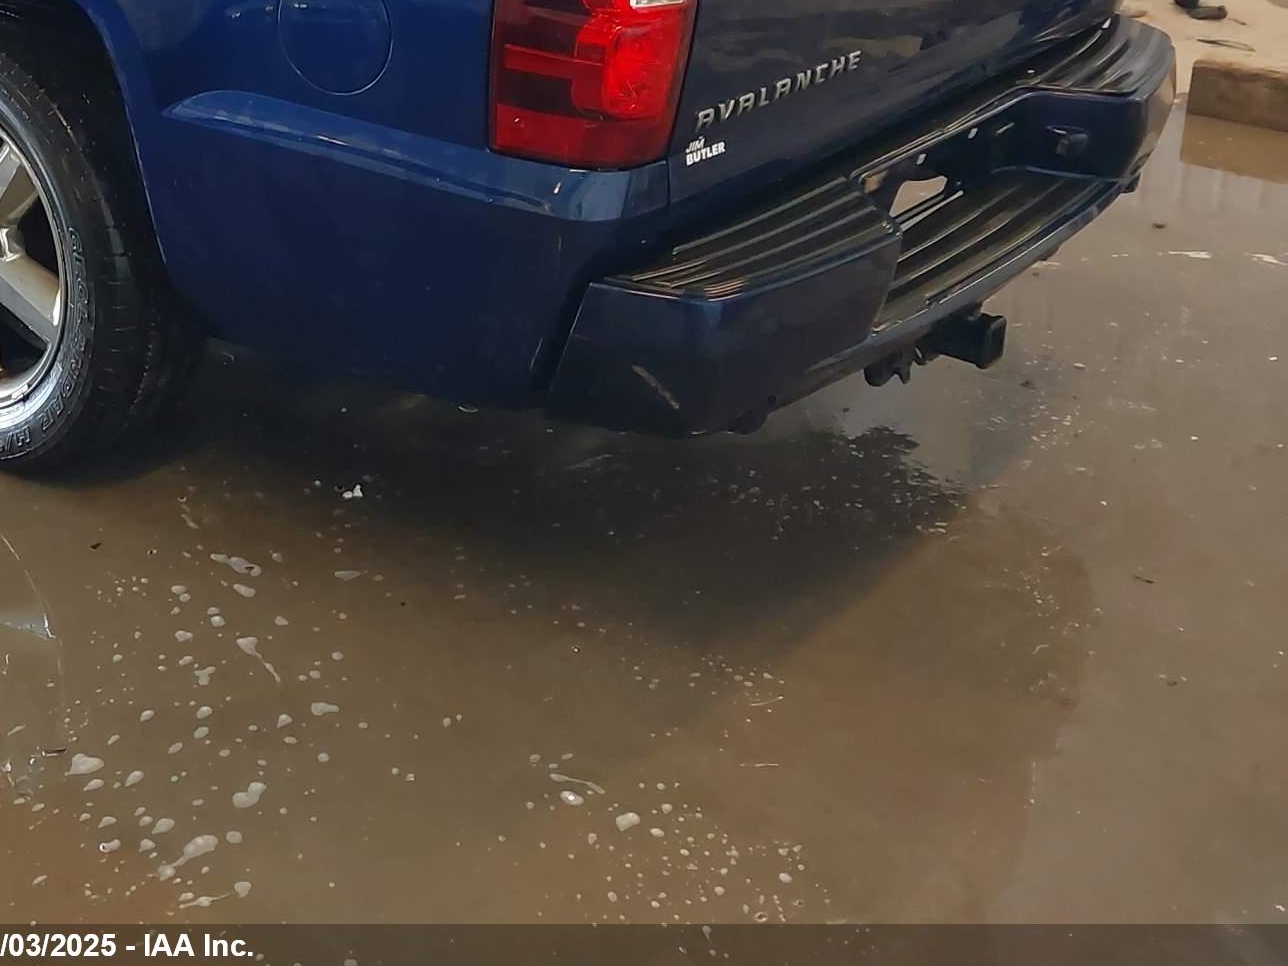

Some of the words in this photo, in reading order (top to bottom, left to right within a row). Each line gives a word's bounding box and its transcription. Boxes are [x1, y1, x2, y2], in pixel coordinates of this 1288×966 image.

[695, 50, 862, 133] AVALANCHE
[685, 136, 706, 154] JIM
[686, 141, 726, 166] BUTLER
